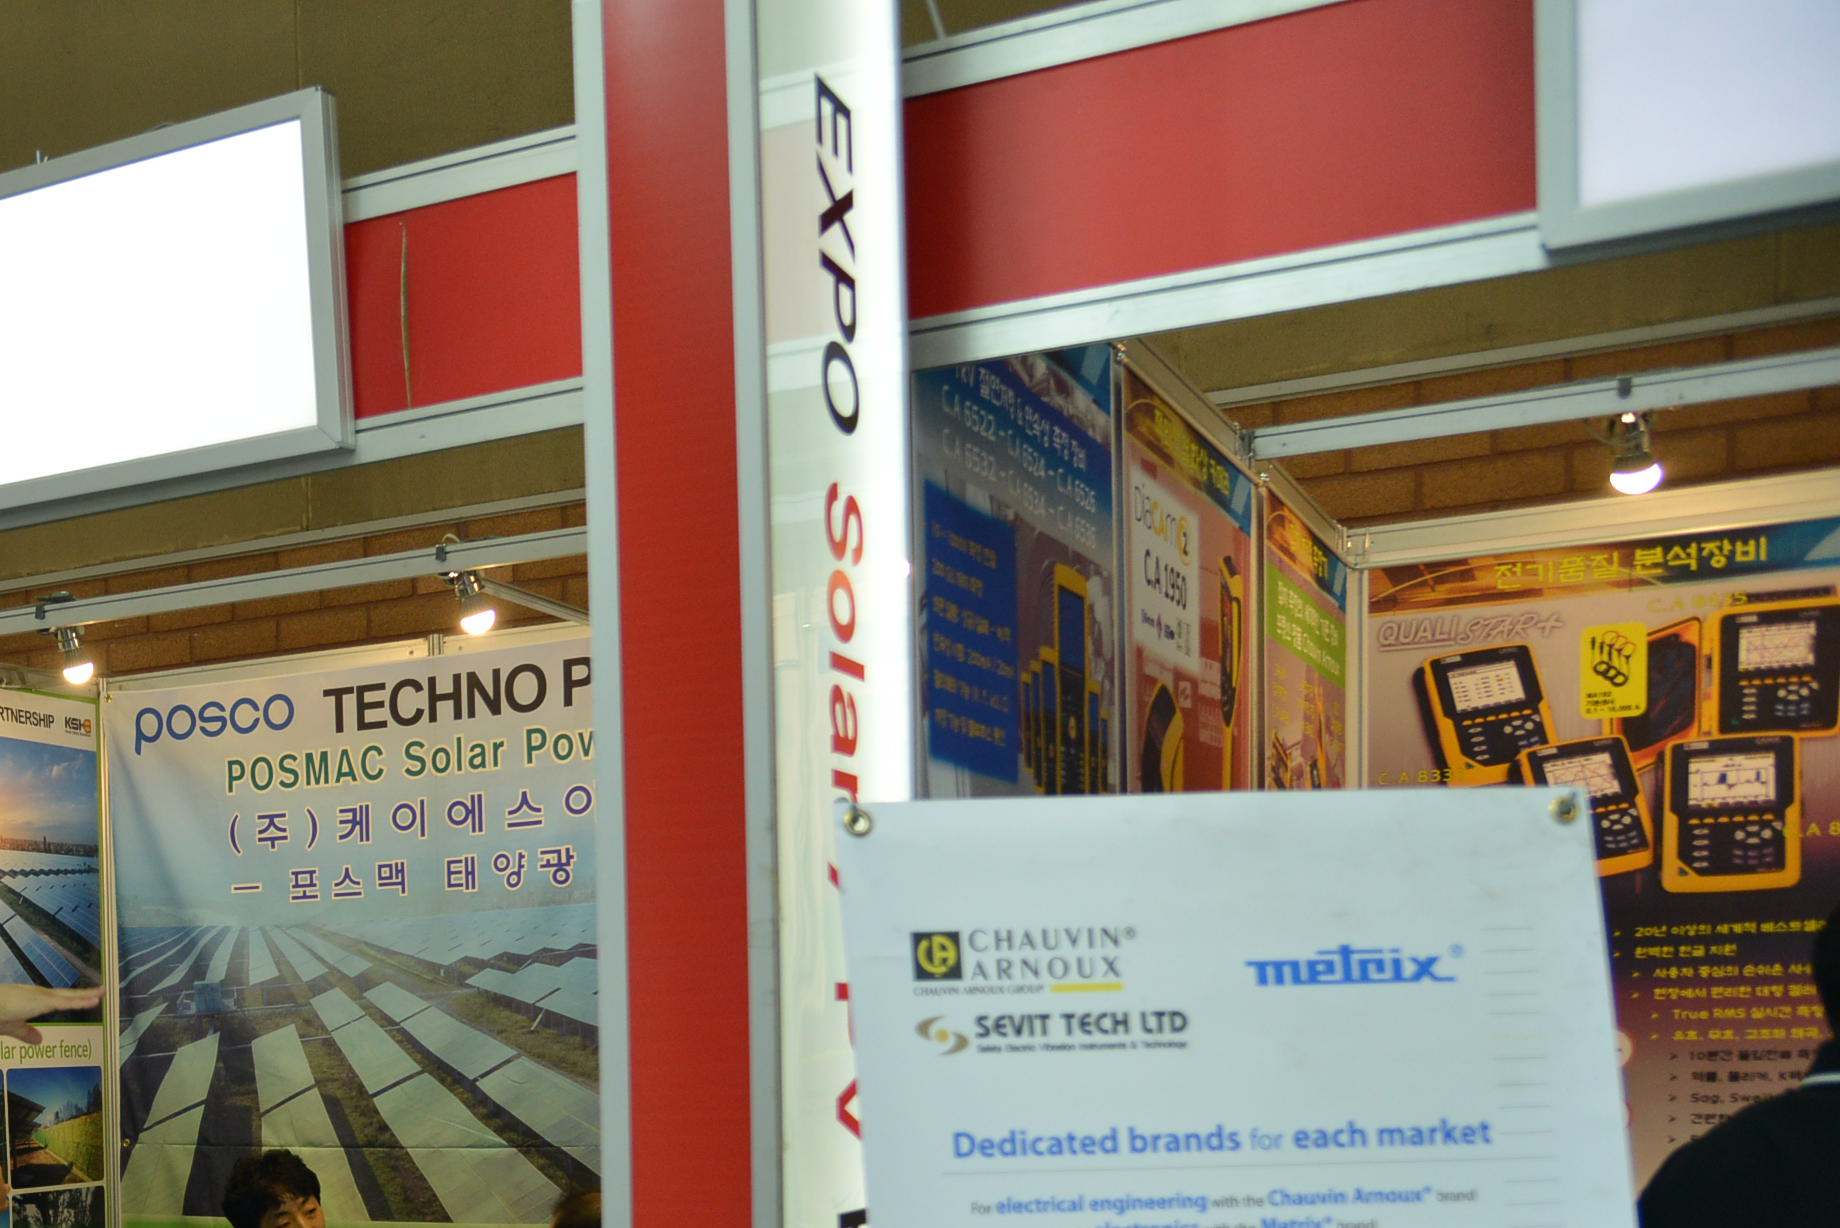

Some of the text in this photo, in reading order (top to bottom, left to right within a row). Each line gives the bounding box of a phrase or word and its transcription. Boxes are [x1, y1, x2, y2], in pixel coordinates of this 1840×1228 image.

[814, 72, 860, 436] EXPO
[1494, 535, 1768, 590] 전기품질 분석장비
[824, 481, 865, 806] Solar
[134, 692, 296, 756] posco
[322, 662, 548, 734] TECHNO
[226, 743, 385, 793] POSMAC
[403, 736, 506, 779] Solar
[290, 846, 575, 902] 포스맥 태양광
[971, 955, 1123, 982] ARNOUX
[974, 1009, 1190, 1039] SEVIT TECH LTD
[1672, 1009, 1709, 1020] True
[1713, 1007, 1747, 1019] RMS
[19, 1044, 58, 1064] power
[60, 1039, 92, 1060] fence)
[952, 1118, 1492, 1160] Dedicated brands for each market
[996, 1195, 1084, 1216] electrical
[1089, 1192, 1209, 1217] engineering
[1267, 1188, 1346, 1208] Chauvin
